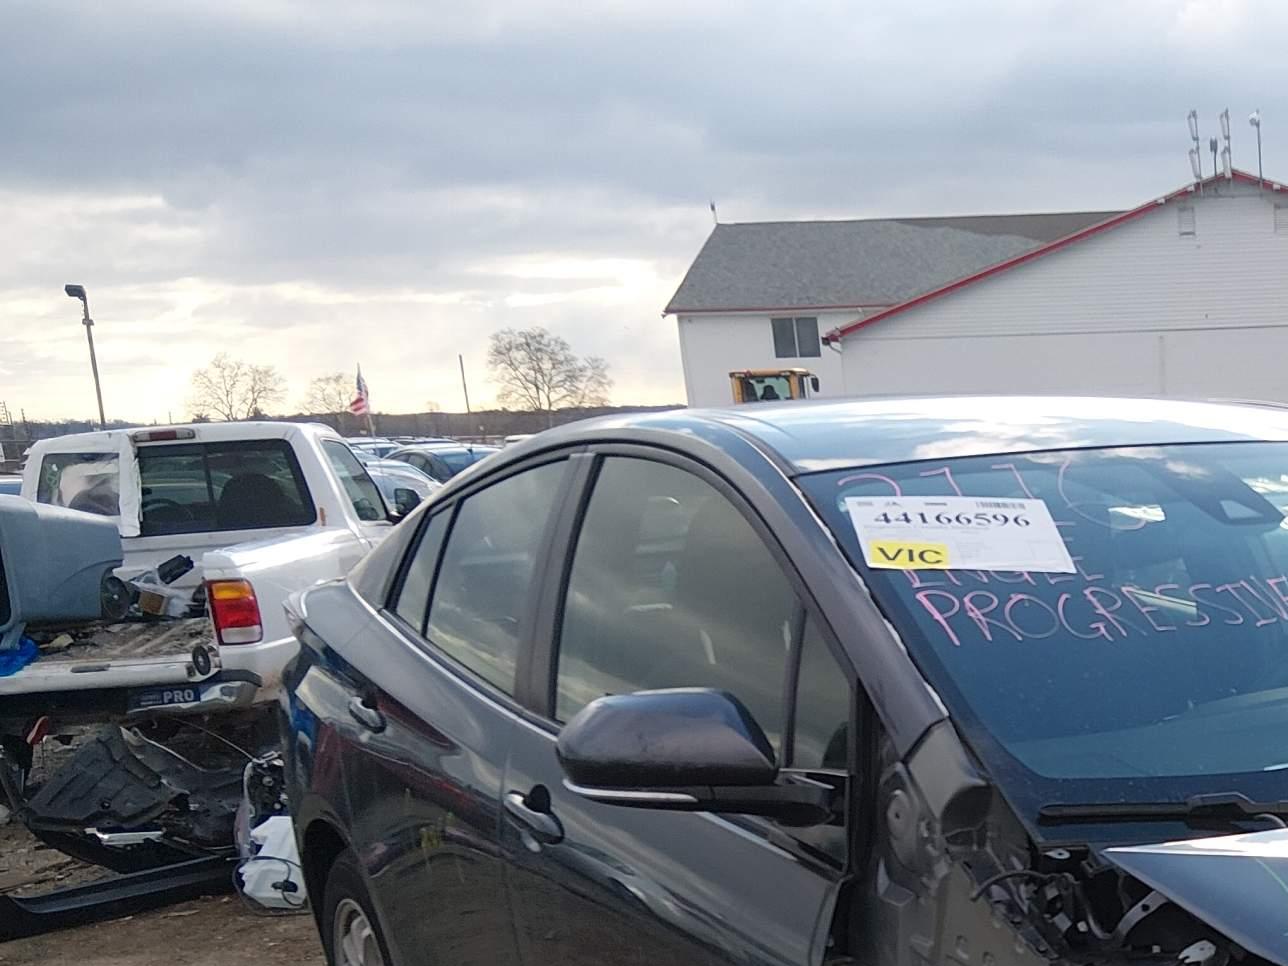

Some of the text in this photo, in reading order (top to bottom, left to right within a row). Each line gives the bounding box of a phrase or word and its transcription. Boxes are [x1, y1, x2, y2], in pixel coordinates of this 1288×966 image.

[873, 510, 1031, 529] 44166596
[876, 545, 943, 566] VIC
[162, 688, 195, 704] PRO
